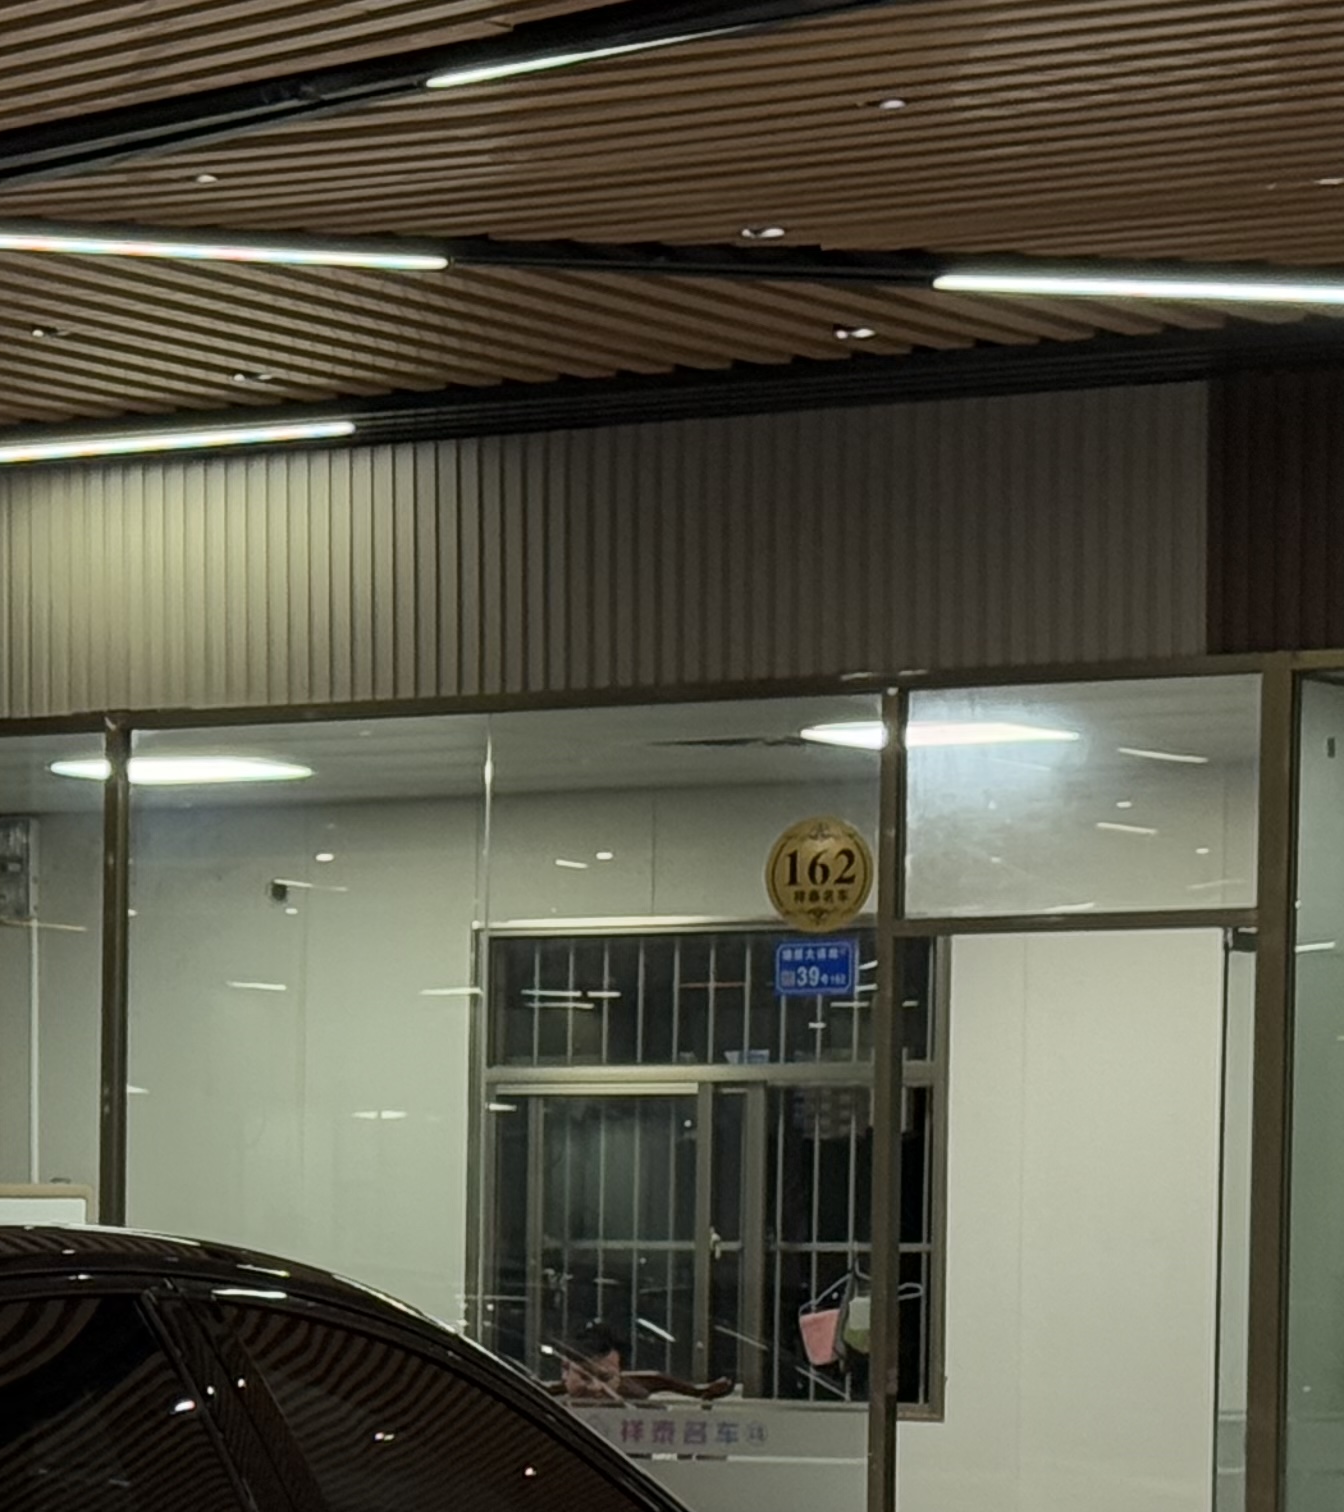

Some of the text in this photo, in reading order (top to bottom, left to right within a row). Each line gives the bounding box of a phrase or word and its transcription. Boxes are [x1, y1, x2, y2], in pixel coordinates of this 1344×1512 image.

[785, 848, 857, 886] 162
[620, 1418, 740, 1445] 祥泰名车
